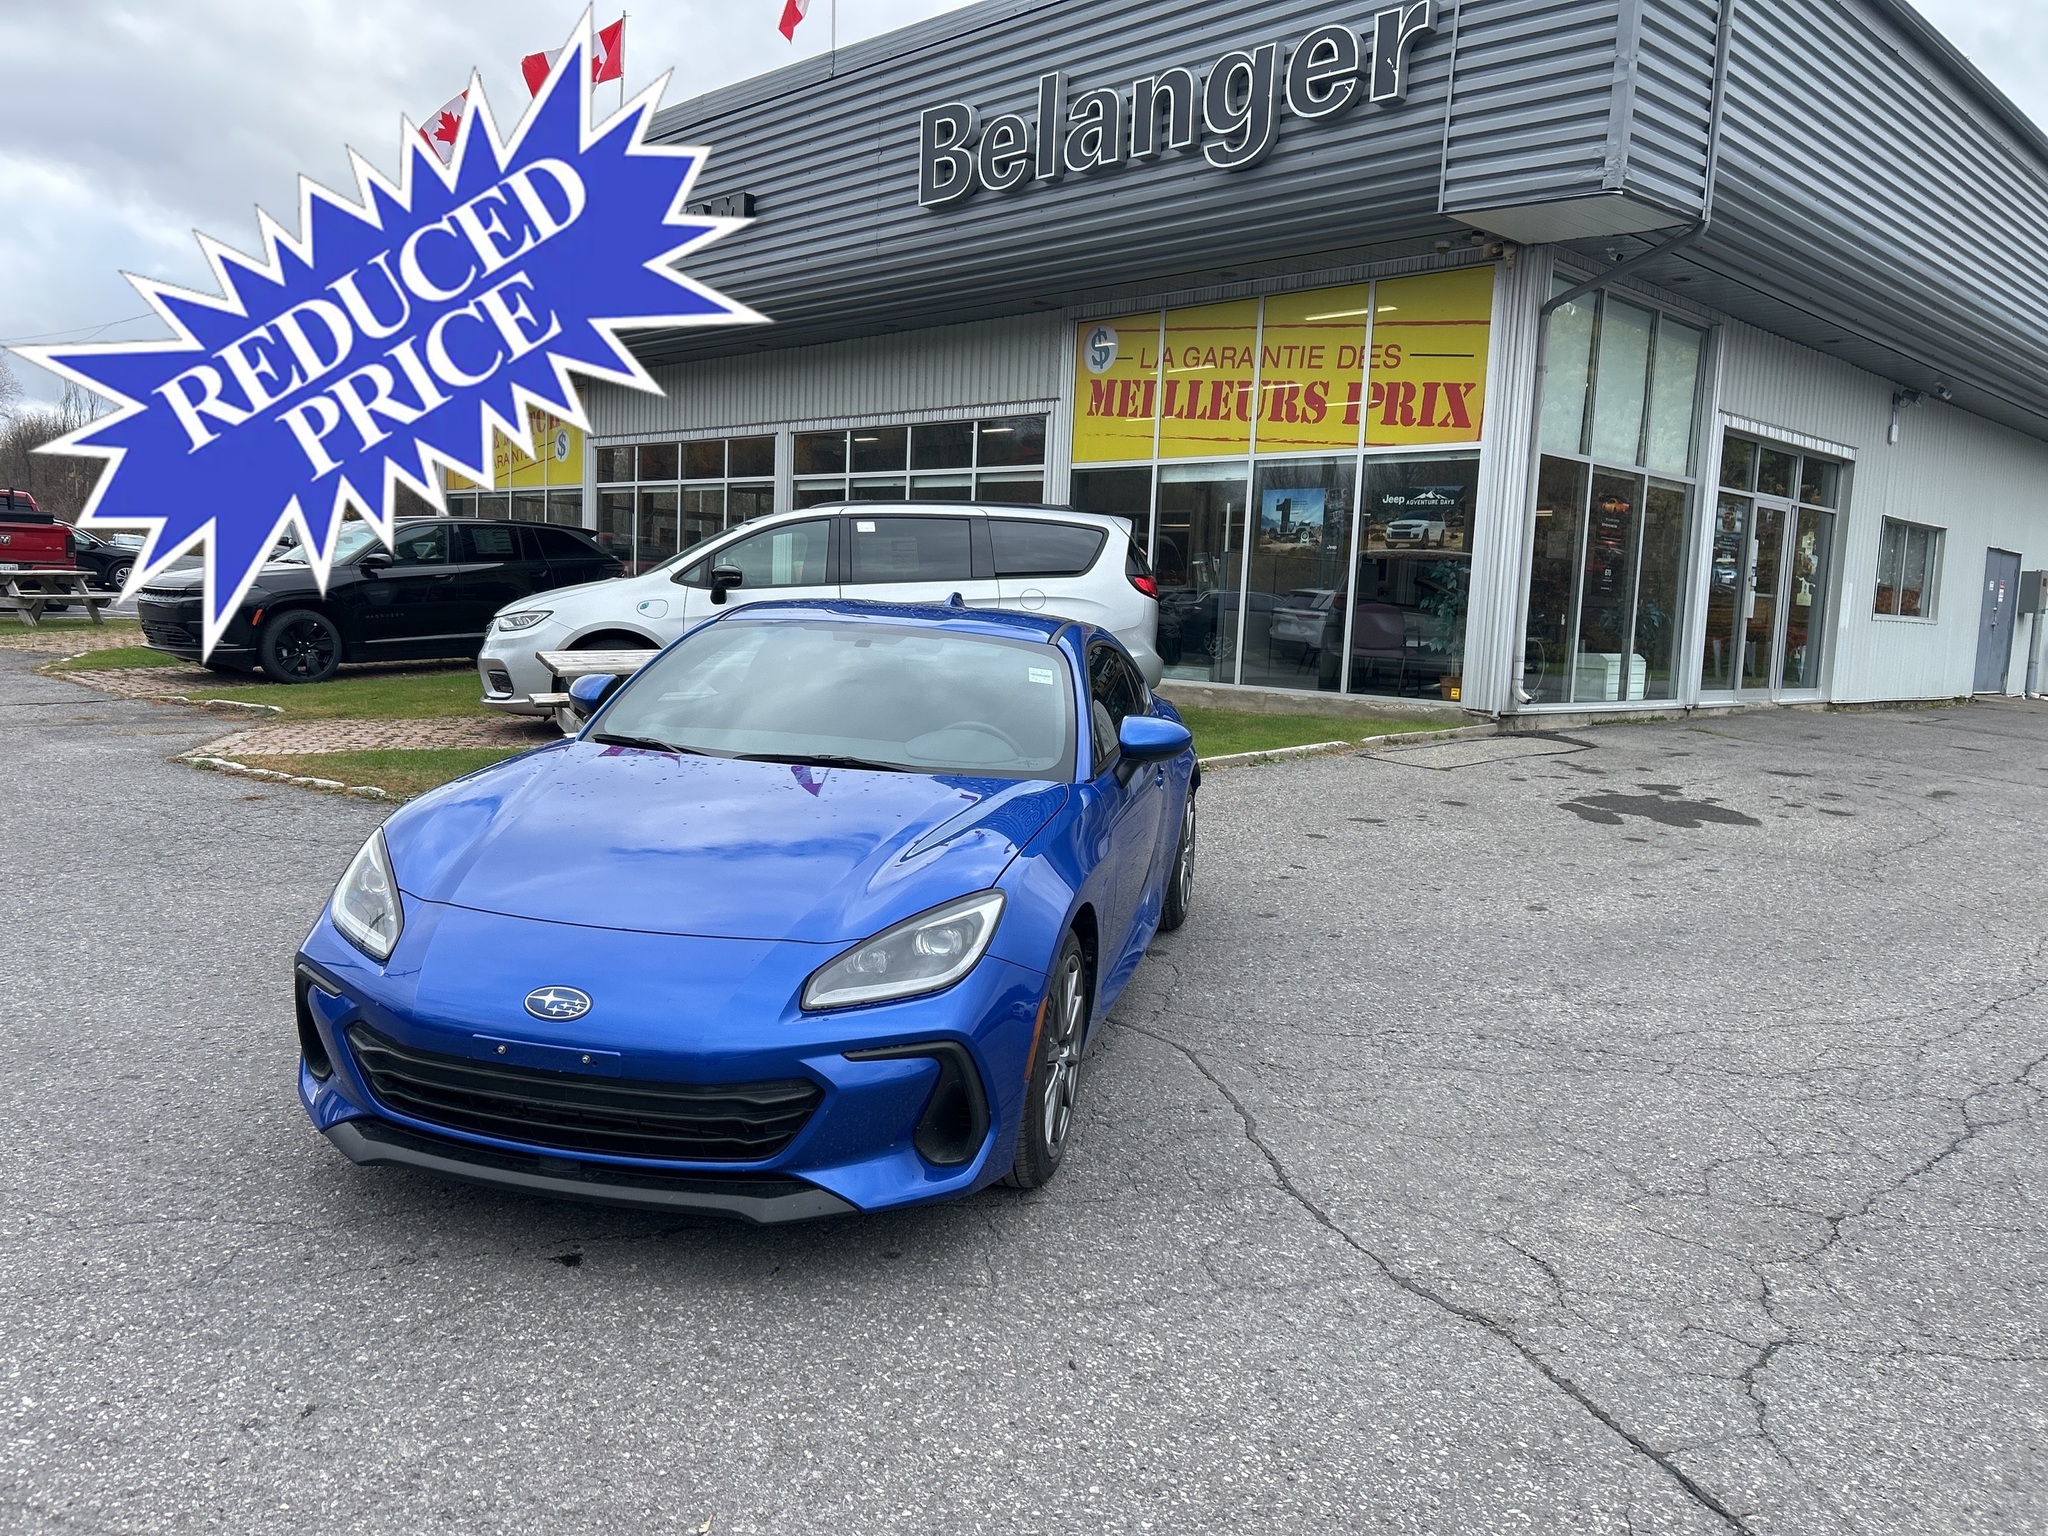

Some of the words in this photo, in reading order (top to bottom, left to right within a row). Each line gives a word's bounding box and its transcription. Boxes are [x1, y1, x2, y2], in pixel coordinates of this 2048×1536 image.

[918, 0, 1438, 208] Belanger
[1139, 347, 1175, 369] LA
[1183, 345, 1326, 369] GARANTIE
[1336, 344, 1402, 369] DES
[1086, 379, 1330, 424] MEILLEURS
[1342, 381, 1477, 428] PRIX
[1382, 494, 1405, 505] Jeep
